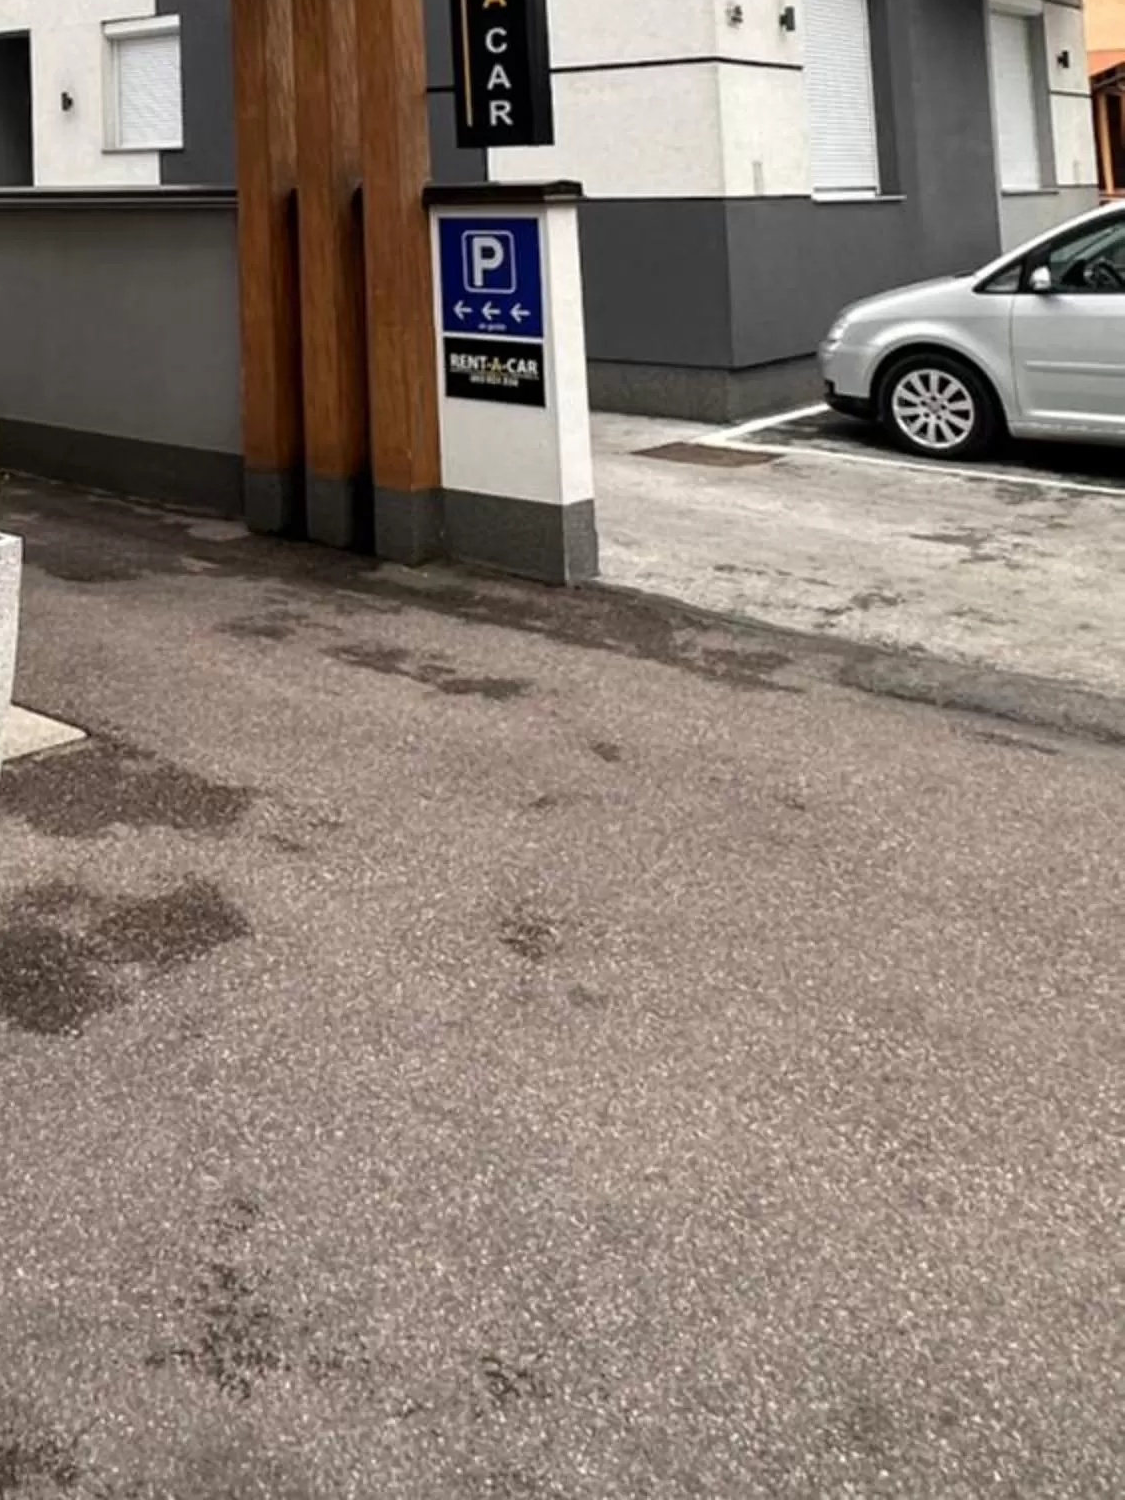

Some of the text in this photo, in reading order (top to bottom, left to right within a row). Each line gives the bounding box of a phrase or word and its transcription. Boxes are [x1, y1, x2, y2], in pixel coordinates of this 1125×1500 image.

[485, 27, 513, 127] CAR
[472, 236, 504, 287] P
[450, 352, 539, 375] RENT-A-CAR
